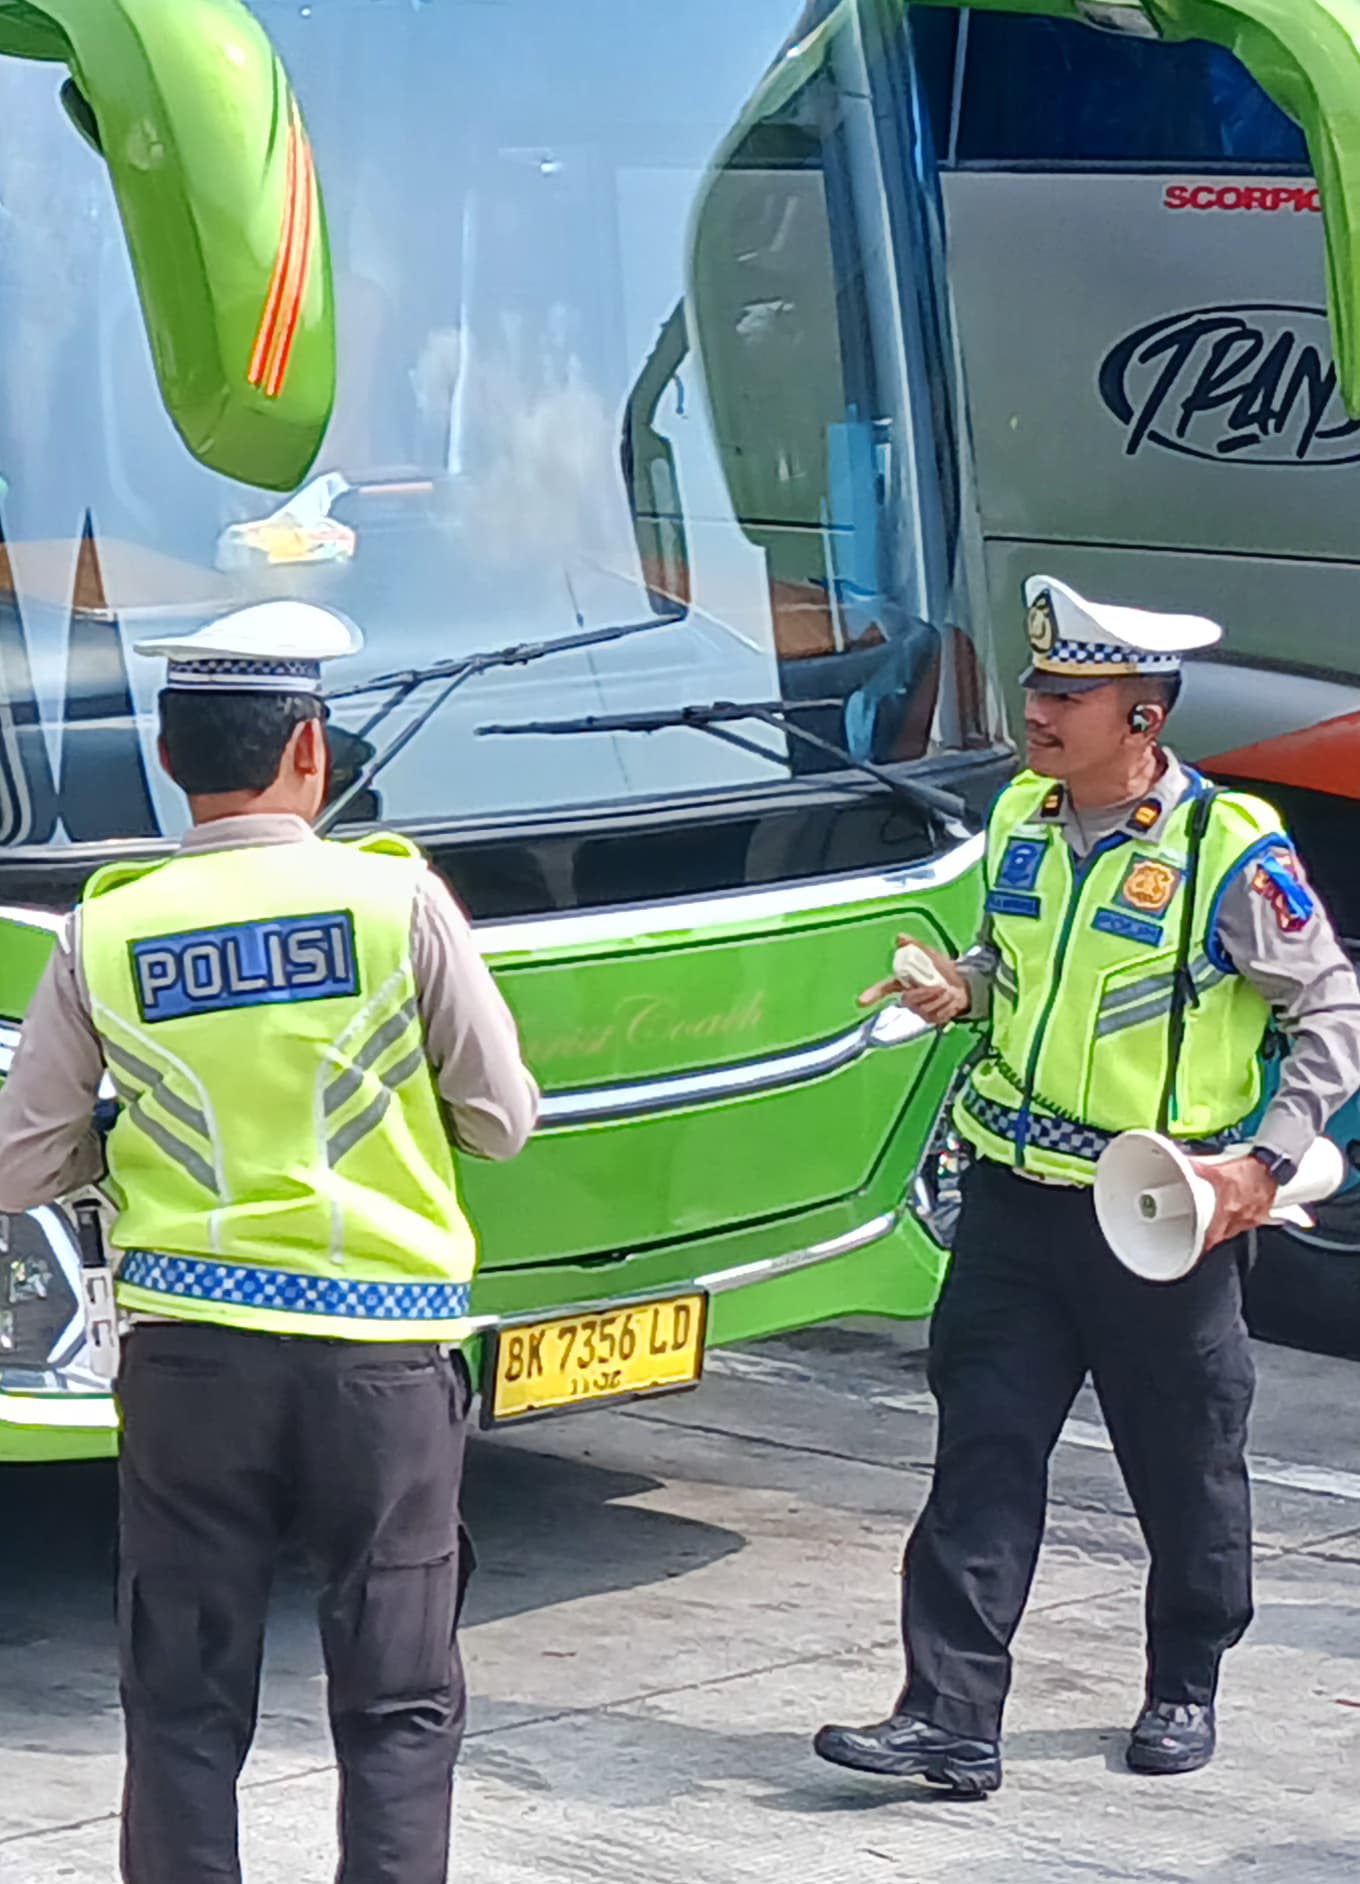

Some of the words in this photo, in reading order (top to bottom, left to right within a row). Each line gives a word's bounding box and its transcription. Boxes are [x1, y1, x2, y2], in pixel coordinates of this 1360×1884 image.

[138, 926, 351, 1006] POLISI
[504, 1329, 546, 1382] BK
[557, 1313, 637, 1374] 7356
[649, 1304, 691, 1356] LD
